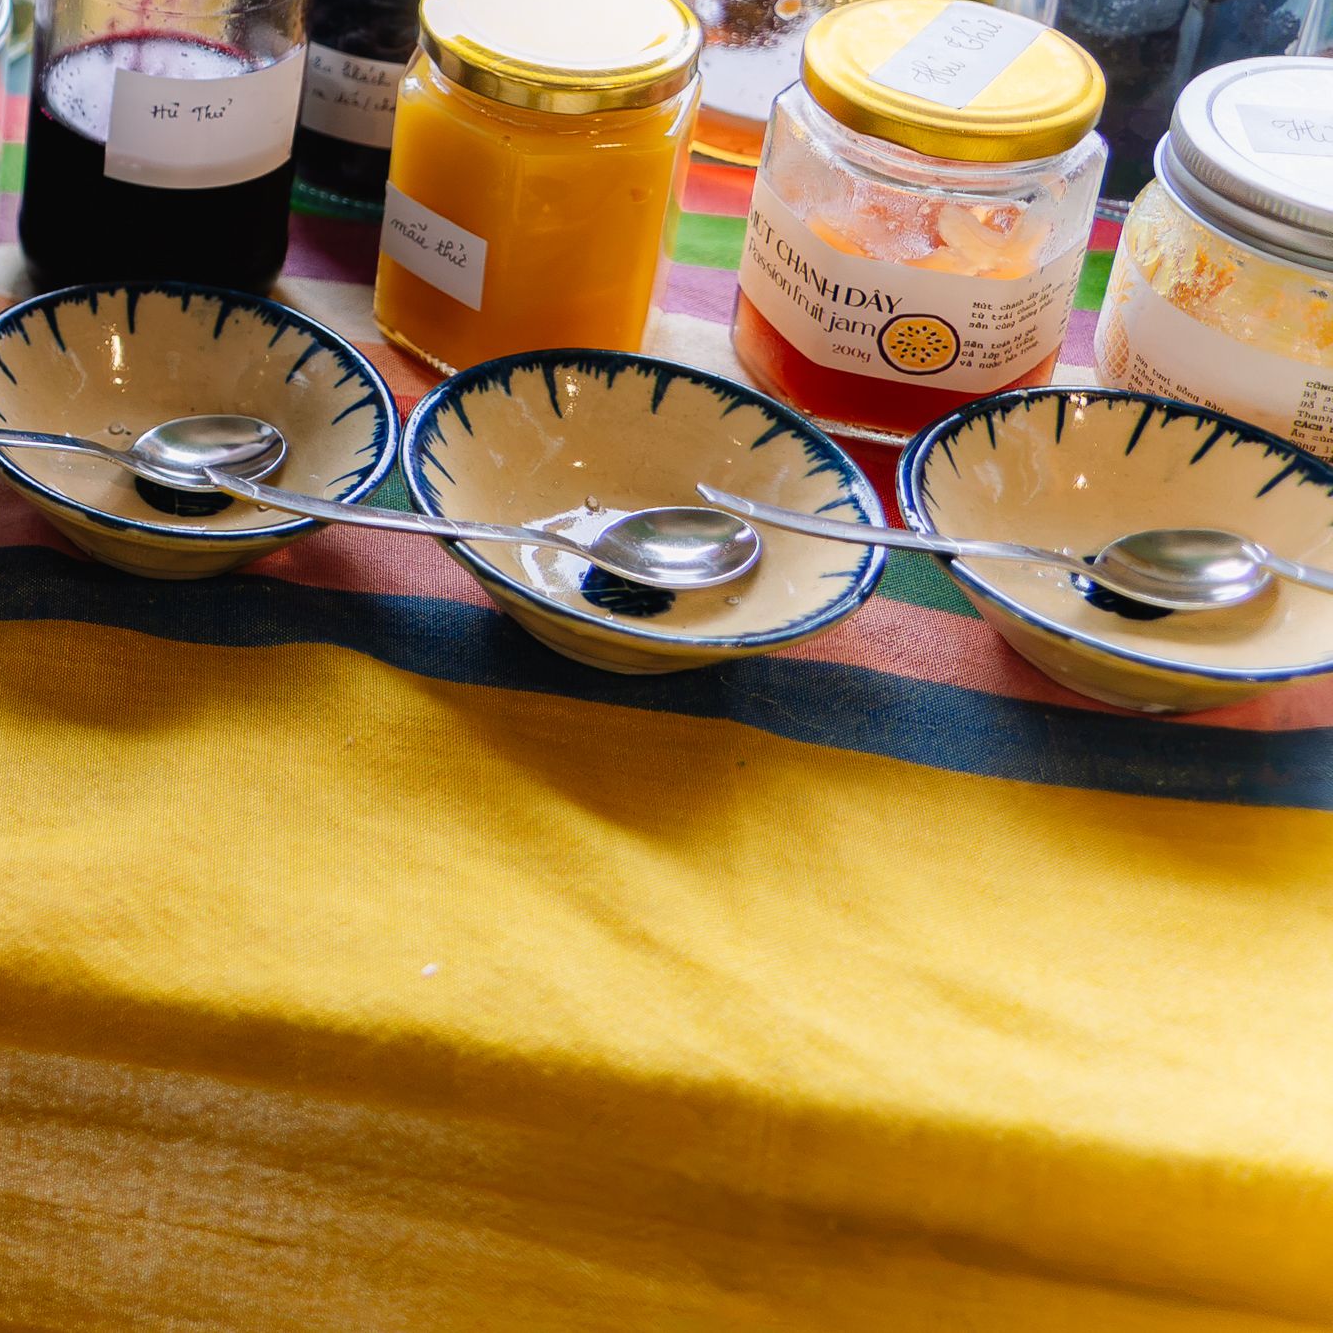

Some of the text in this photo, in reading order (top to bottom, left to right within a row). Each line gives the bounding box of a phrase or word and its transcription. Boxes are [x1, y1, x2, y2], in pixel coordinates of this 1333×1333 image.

[749, 237, 876, 337] Passion fruit jam
[776, 239, 840, 303] CHANH
[844, 287, 903, 315] DÂY
[832, 343, 872, 363] 200g
